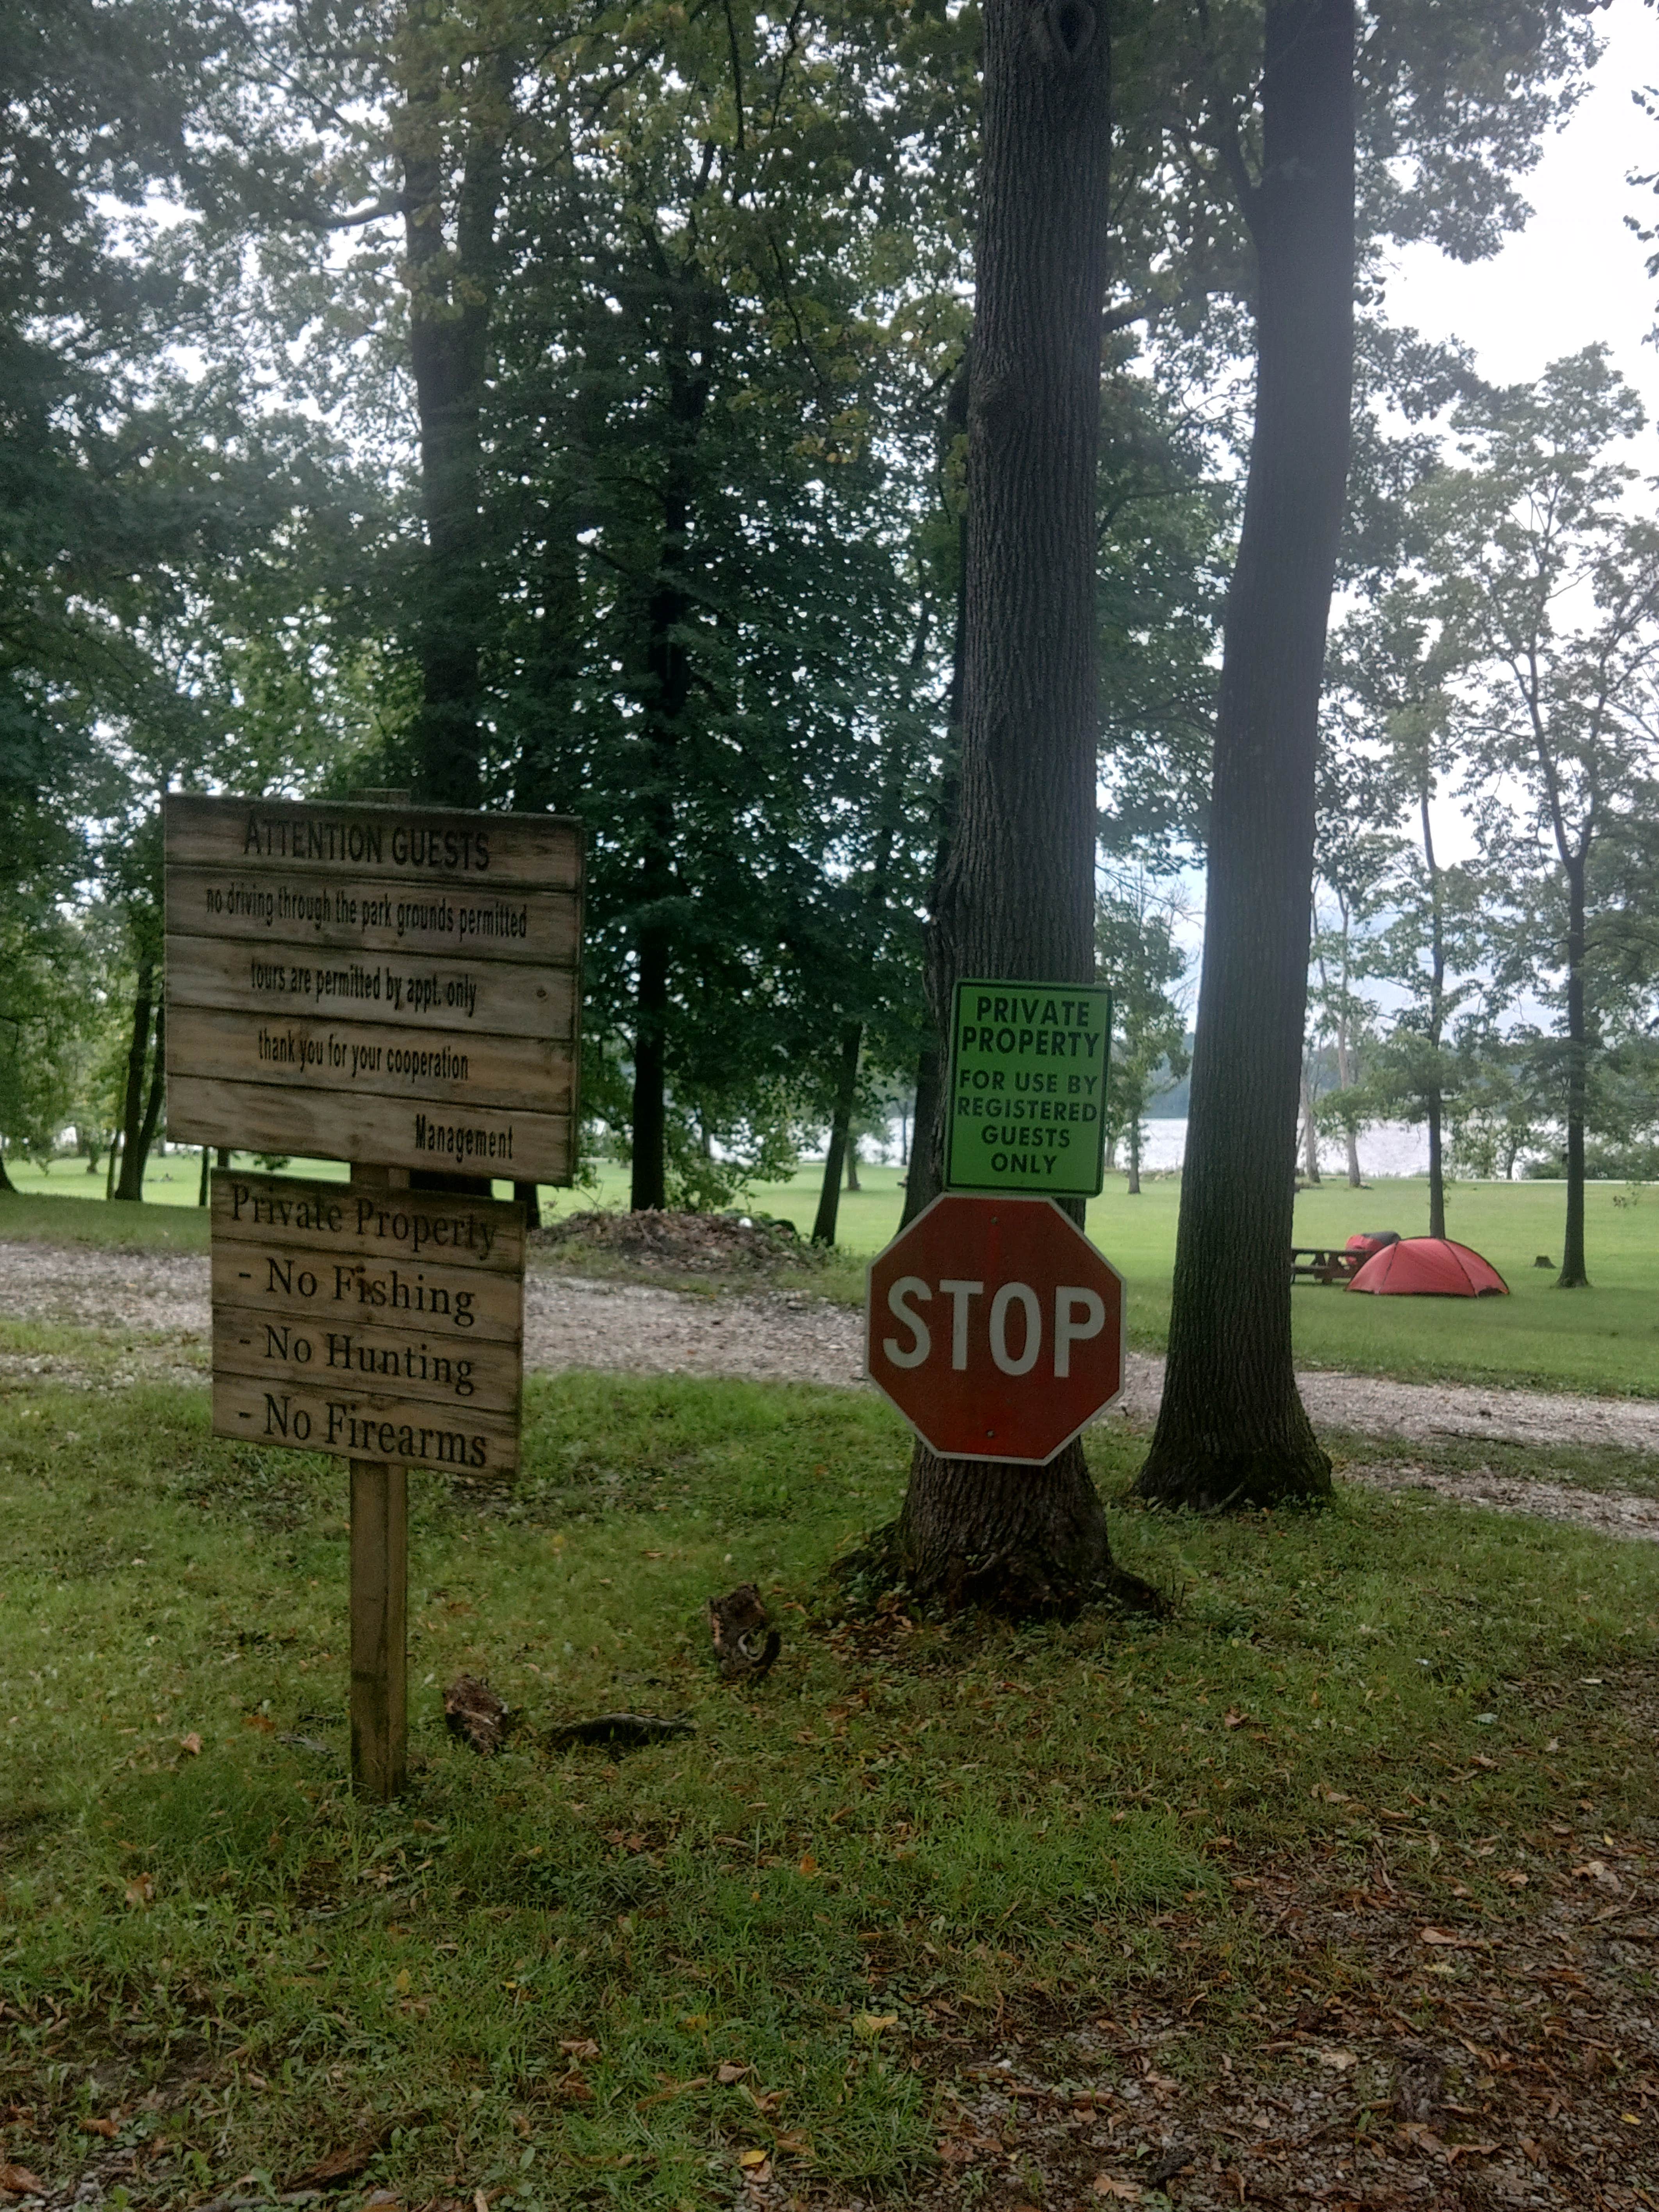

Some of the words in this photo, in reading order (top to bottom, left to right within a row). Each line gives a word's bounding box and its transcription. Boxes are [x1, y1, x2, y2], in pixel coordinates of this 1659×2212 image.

[244, 812, 383, 863] ATTENTION
[392, 827, 490, 871] GUESTS
[207, 888, 222, 913] no
[227, 882, 273, 927] driving
[278, 886, 331, 931] through
[336, 889, 357, 923] the
[362, 893, 391, 933] park
[397, 898, 454, 937] grounds
[459, 901, 527, 942] permitted
[251, 958, 285, 991] tours
[290, 967, 311, 993] are
[316, 964, 380, 1003] permitted
[386, 967, 402, 1010] by
[407, 972, 441, 1013] appt.
[446, 974, 477, 1017] only
[977, 996, 1090, 1027] PRIVATE
[259, 1028, 295, 1062] thank
[300, 1037, 323, 1073] you
[328, 1033, 347, 1067] for
[351, 1044, 382, 1078] your
[386, 1045, 468, 1083] cooperation
[962, 1026, 1101, 1058] PROPERTY
[957, 1096, 1097, 1122] REGISTERED
[959, 1069, 1005, 1090] FOR
[1015, 1072, 1058, 1093] USE
[1067, 1075, 1098, 1095] BY
[415, 1114, 513, 1163] Management
[981, 1124, 1071, 1148] GUESTS
[991, 1152, 1058, 1174] ONLY
[230, 1182, 343, 1233] Private
[356, 1197, 497, 1261] Property
[266, 1257, 318, 1297] No
[333, 1265, 475, 1327] Fishing
[882, 1275, 1106, 1378] STOP
[264, 1324, 312, 1364] No
[326, 1333, 474, 1397] Hunting
[263, 1393, 312, 1441] No
[325, 1402, 488, 1468] Firearms
